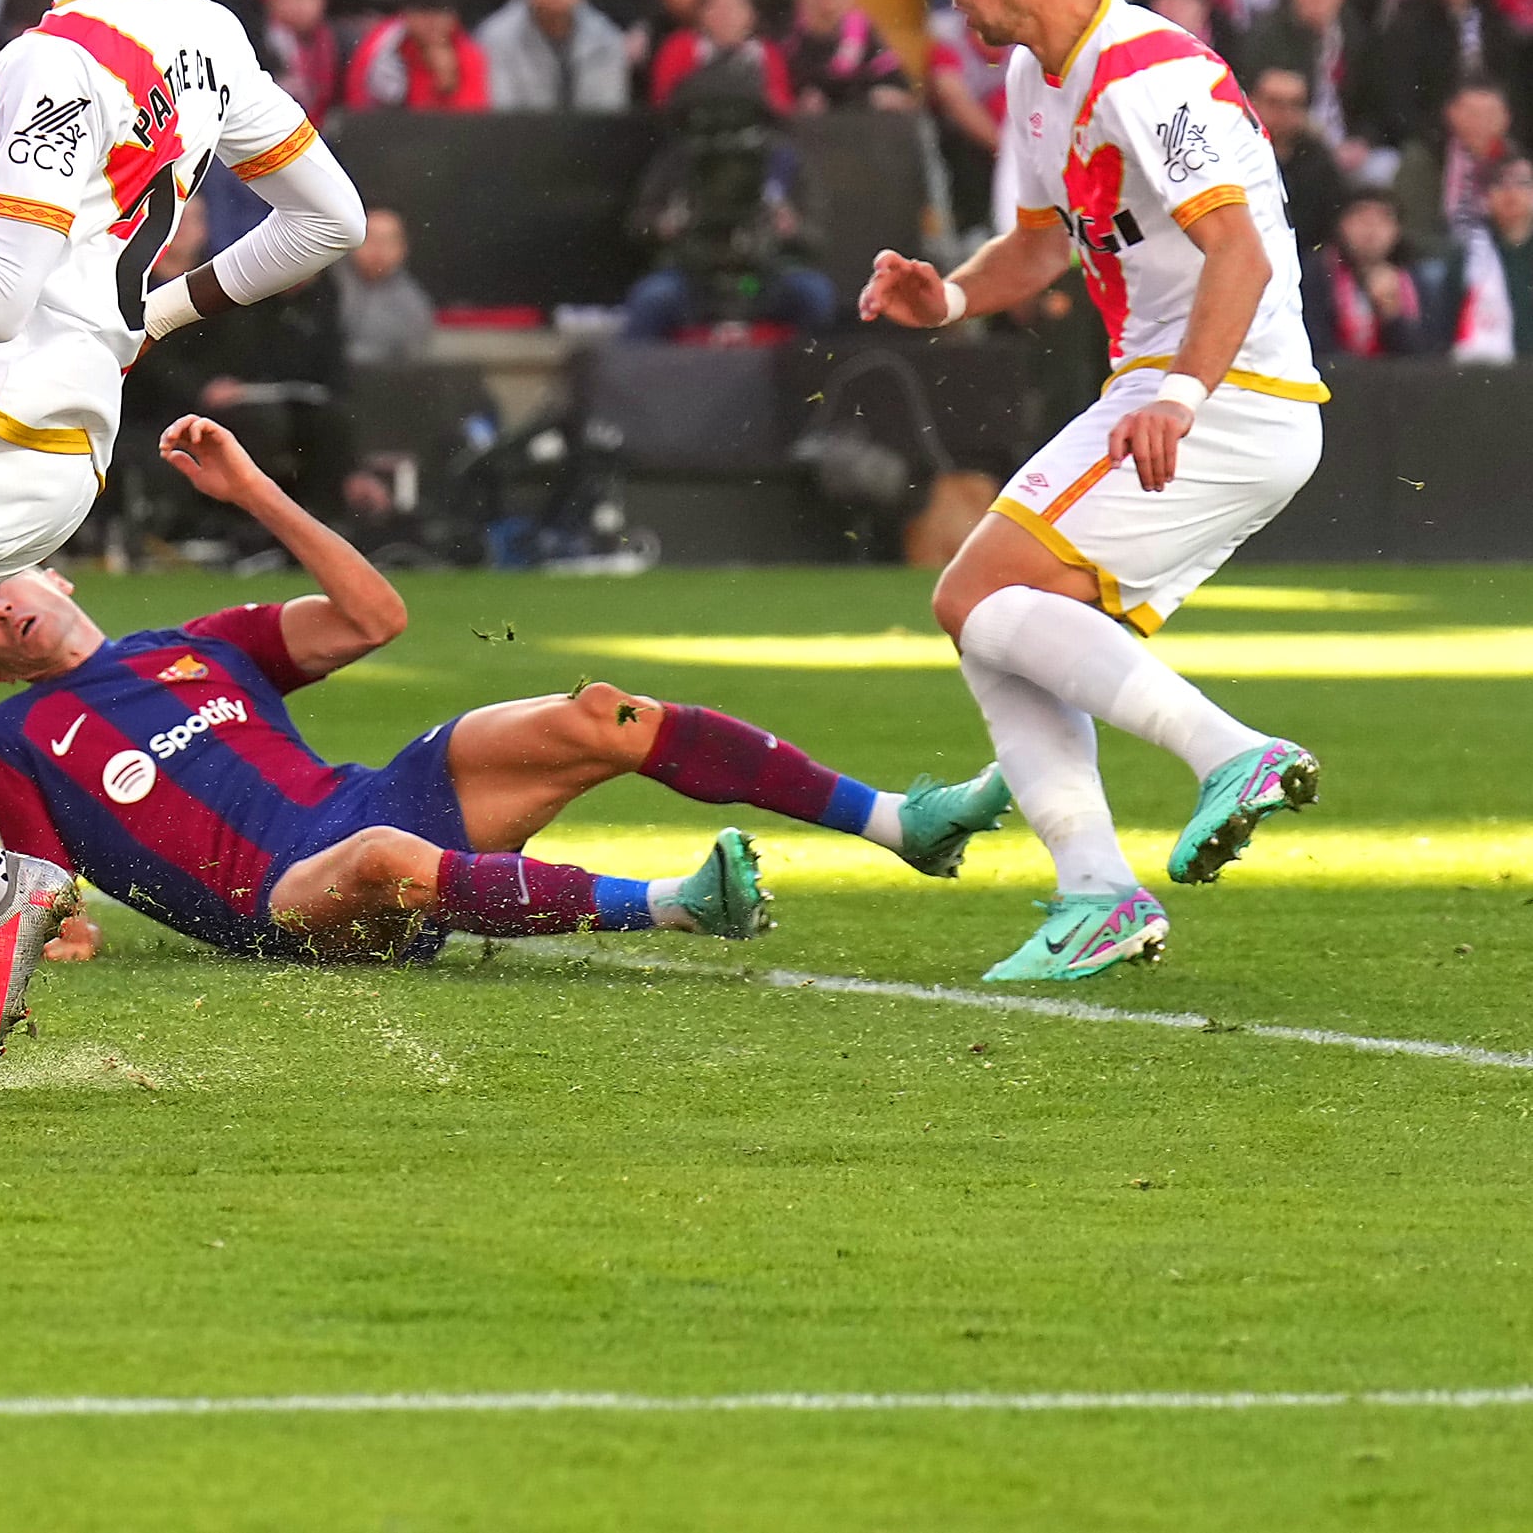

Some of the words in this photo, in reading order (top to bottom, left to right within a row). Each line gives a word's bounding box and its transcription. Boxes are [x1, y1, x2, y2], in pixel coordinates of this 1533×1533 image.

[8, 138, 75, 178] GCS
[1168, 145, 1220, 183] GCS
[148, 695, 250, 761] Spotify
